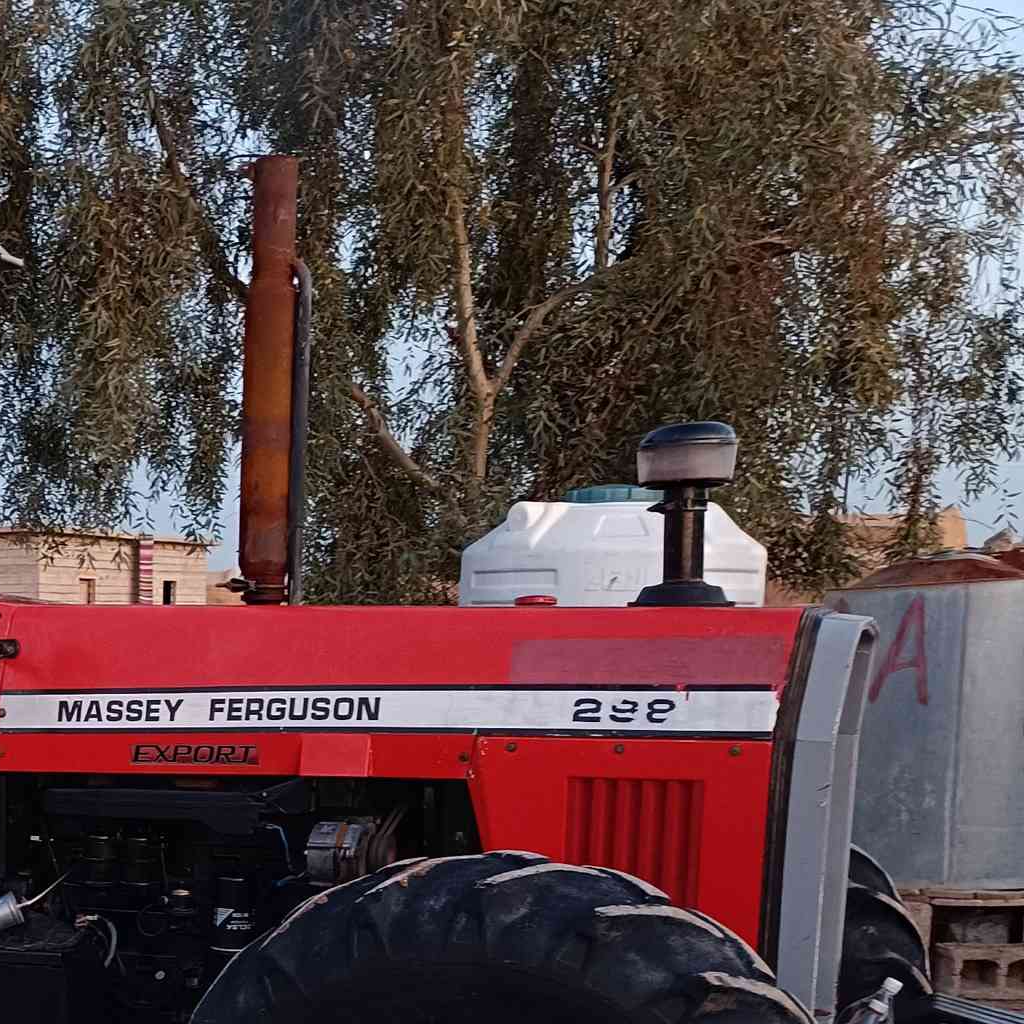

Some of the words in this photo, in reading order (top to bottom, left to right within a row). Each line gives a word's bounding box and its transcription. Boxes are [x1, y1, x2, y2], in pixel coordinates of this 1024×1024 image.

[868, 593, 928, 706] A
[57, 699, 184, 723] MASSEY
[208, 696, 382, 722] FERGUSON
[133, 744, 258, 764] EXPORT
